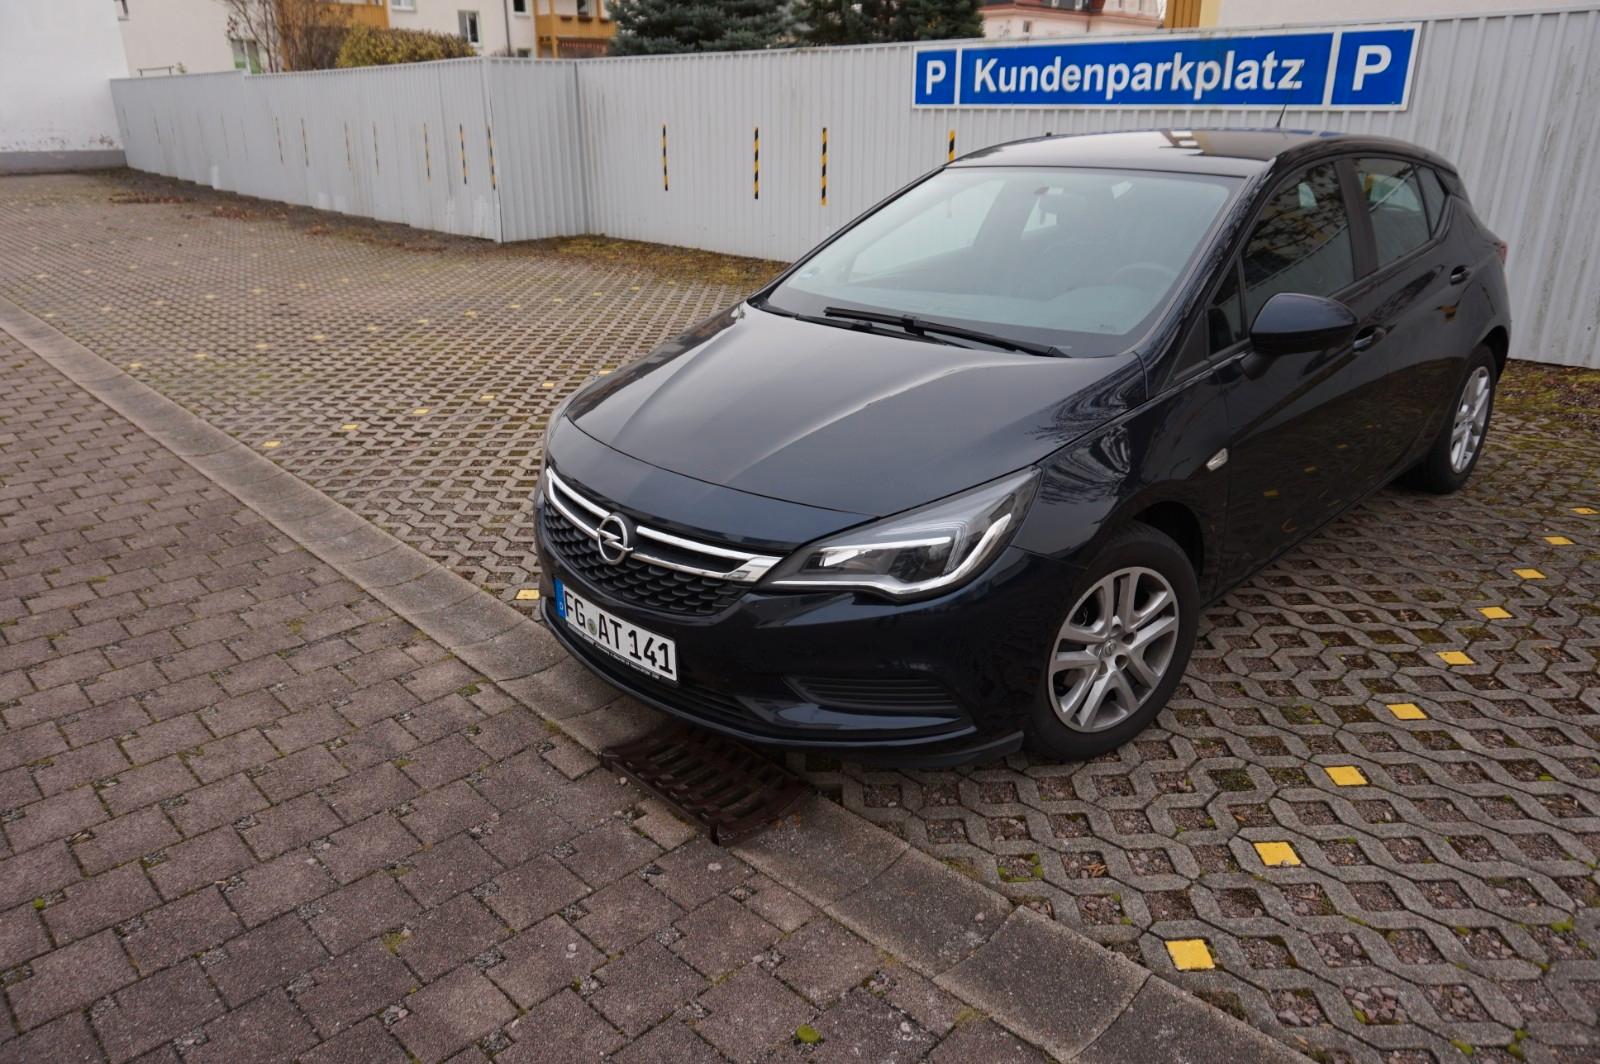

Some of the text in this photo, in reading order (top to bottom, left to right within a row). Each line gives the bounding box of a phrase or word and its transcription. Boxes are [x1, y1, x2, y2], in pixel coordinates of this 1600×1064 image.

[925, 44, 1392, 100] P Kundenparkplatz P
[564, 590, 586, 629] FG
[598, 613, 623, 650] AT
[627, 629, 673, 675] 141
